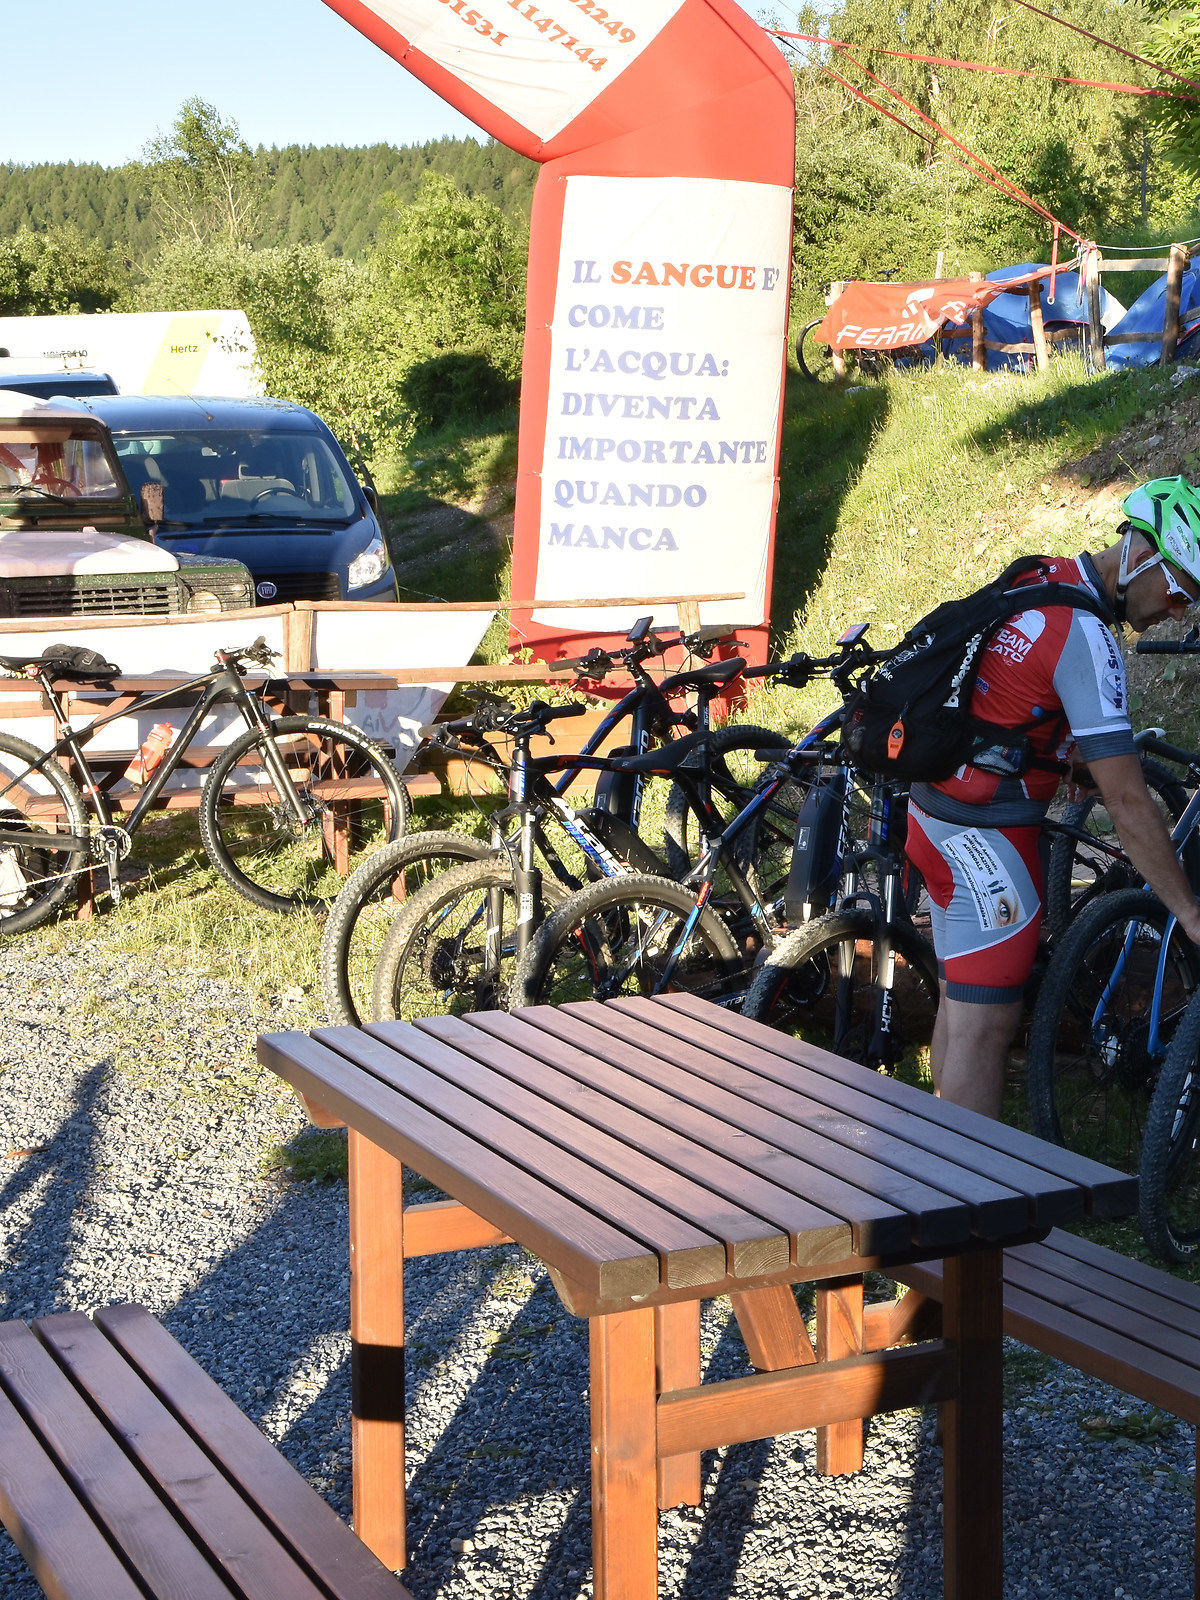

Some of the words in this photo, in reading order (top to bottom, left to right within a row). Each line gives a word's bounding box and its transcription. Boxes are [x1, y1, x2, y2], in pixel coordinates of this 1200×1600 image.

[572, 260, 602, 283] IL
[611, 260, 756, 290] SANGUE
[568, 304, 665, 330] COME
[170, 344, 198, 354] Hertz
[565, 347, 730, 380] L'ACQUA:
[561, 392, 721, 420] DIVENTA
[556, 436, 768, 464] IMPORTANTE
[554, 479, 707, 508] QUANDO
[548, 522, 679, 551] MANCA
